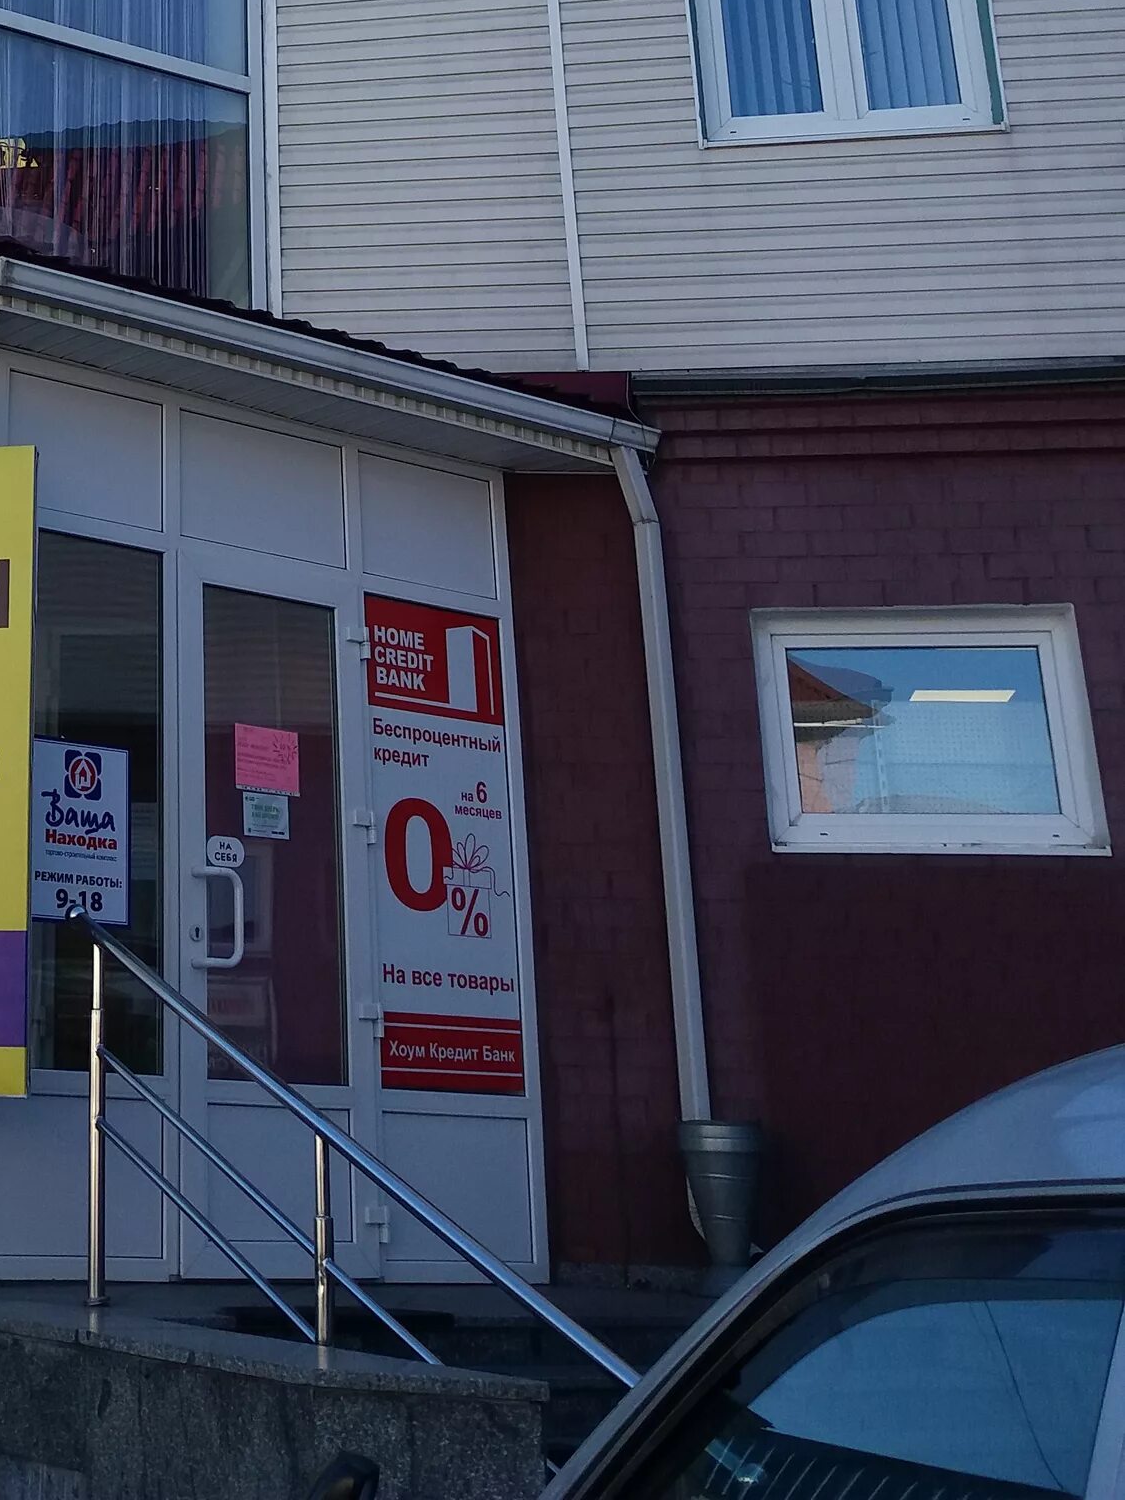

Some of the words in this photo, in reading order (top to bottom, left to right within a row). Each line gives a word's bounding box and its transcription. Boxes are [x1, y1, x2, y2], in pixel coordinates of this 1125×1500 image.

[373, 625, 424, 650] HOME
[374, 646, 433, 672] CREDIT
[376, 667, 425, 691] BANK
[373, 717, 501, 754] Беспроцентный
[373, 746, 429, 767] кредит
[461, 790, 474, 802] на
[476, 781, 487, 803] 6
[41, 788, 115, 835] Ваша
[454, 803, 502, 820] месяцев
[45, 828, 117, 851] Находка
[219, 841, 232, 850] НА
[215, 852, 237, 862] СЕБЯ
[35, 870, 74, 884] РЕЖИМ
[75, 874, 123, 888] РАБОТЫ:
[56, 888, 103, 912] 9-18
[383, 963, 405, 985] На
[412, 969, 442, 987] все
[448, 972, 515, 995] товары
[389, 1040, 425, 1063] Хоум
[429, 1042, 478, 1064] Кредит
[483, 1045, 515, 1063] Банк
